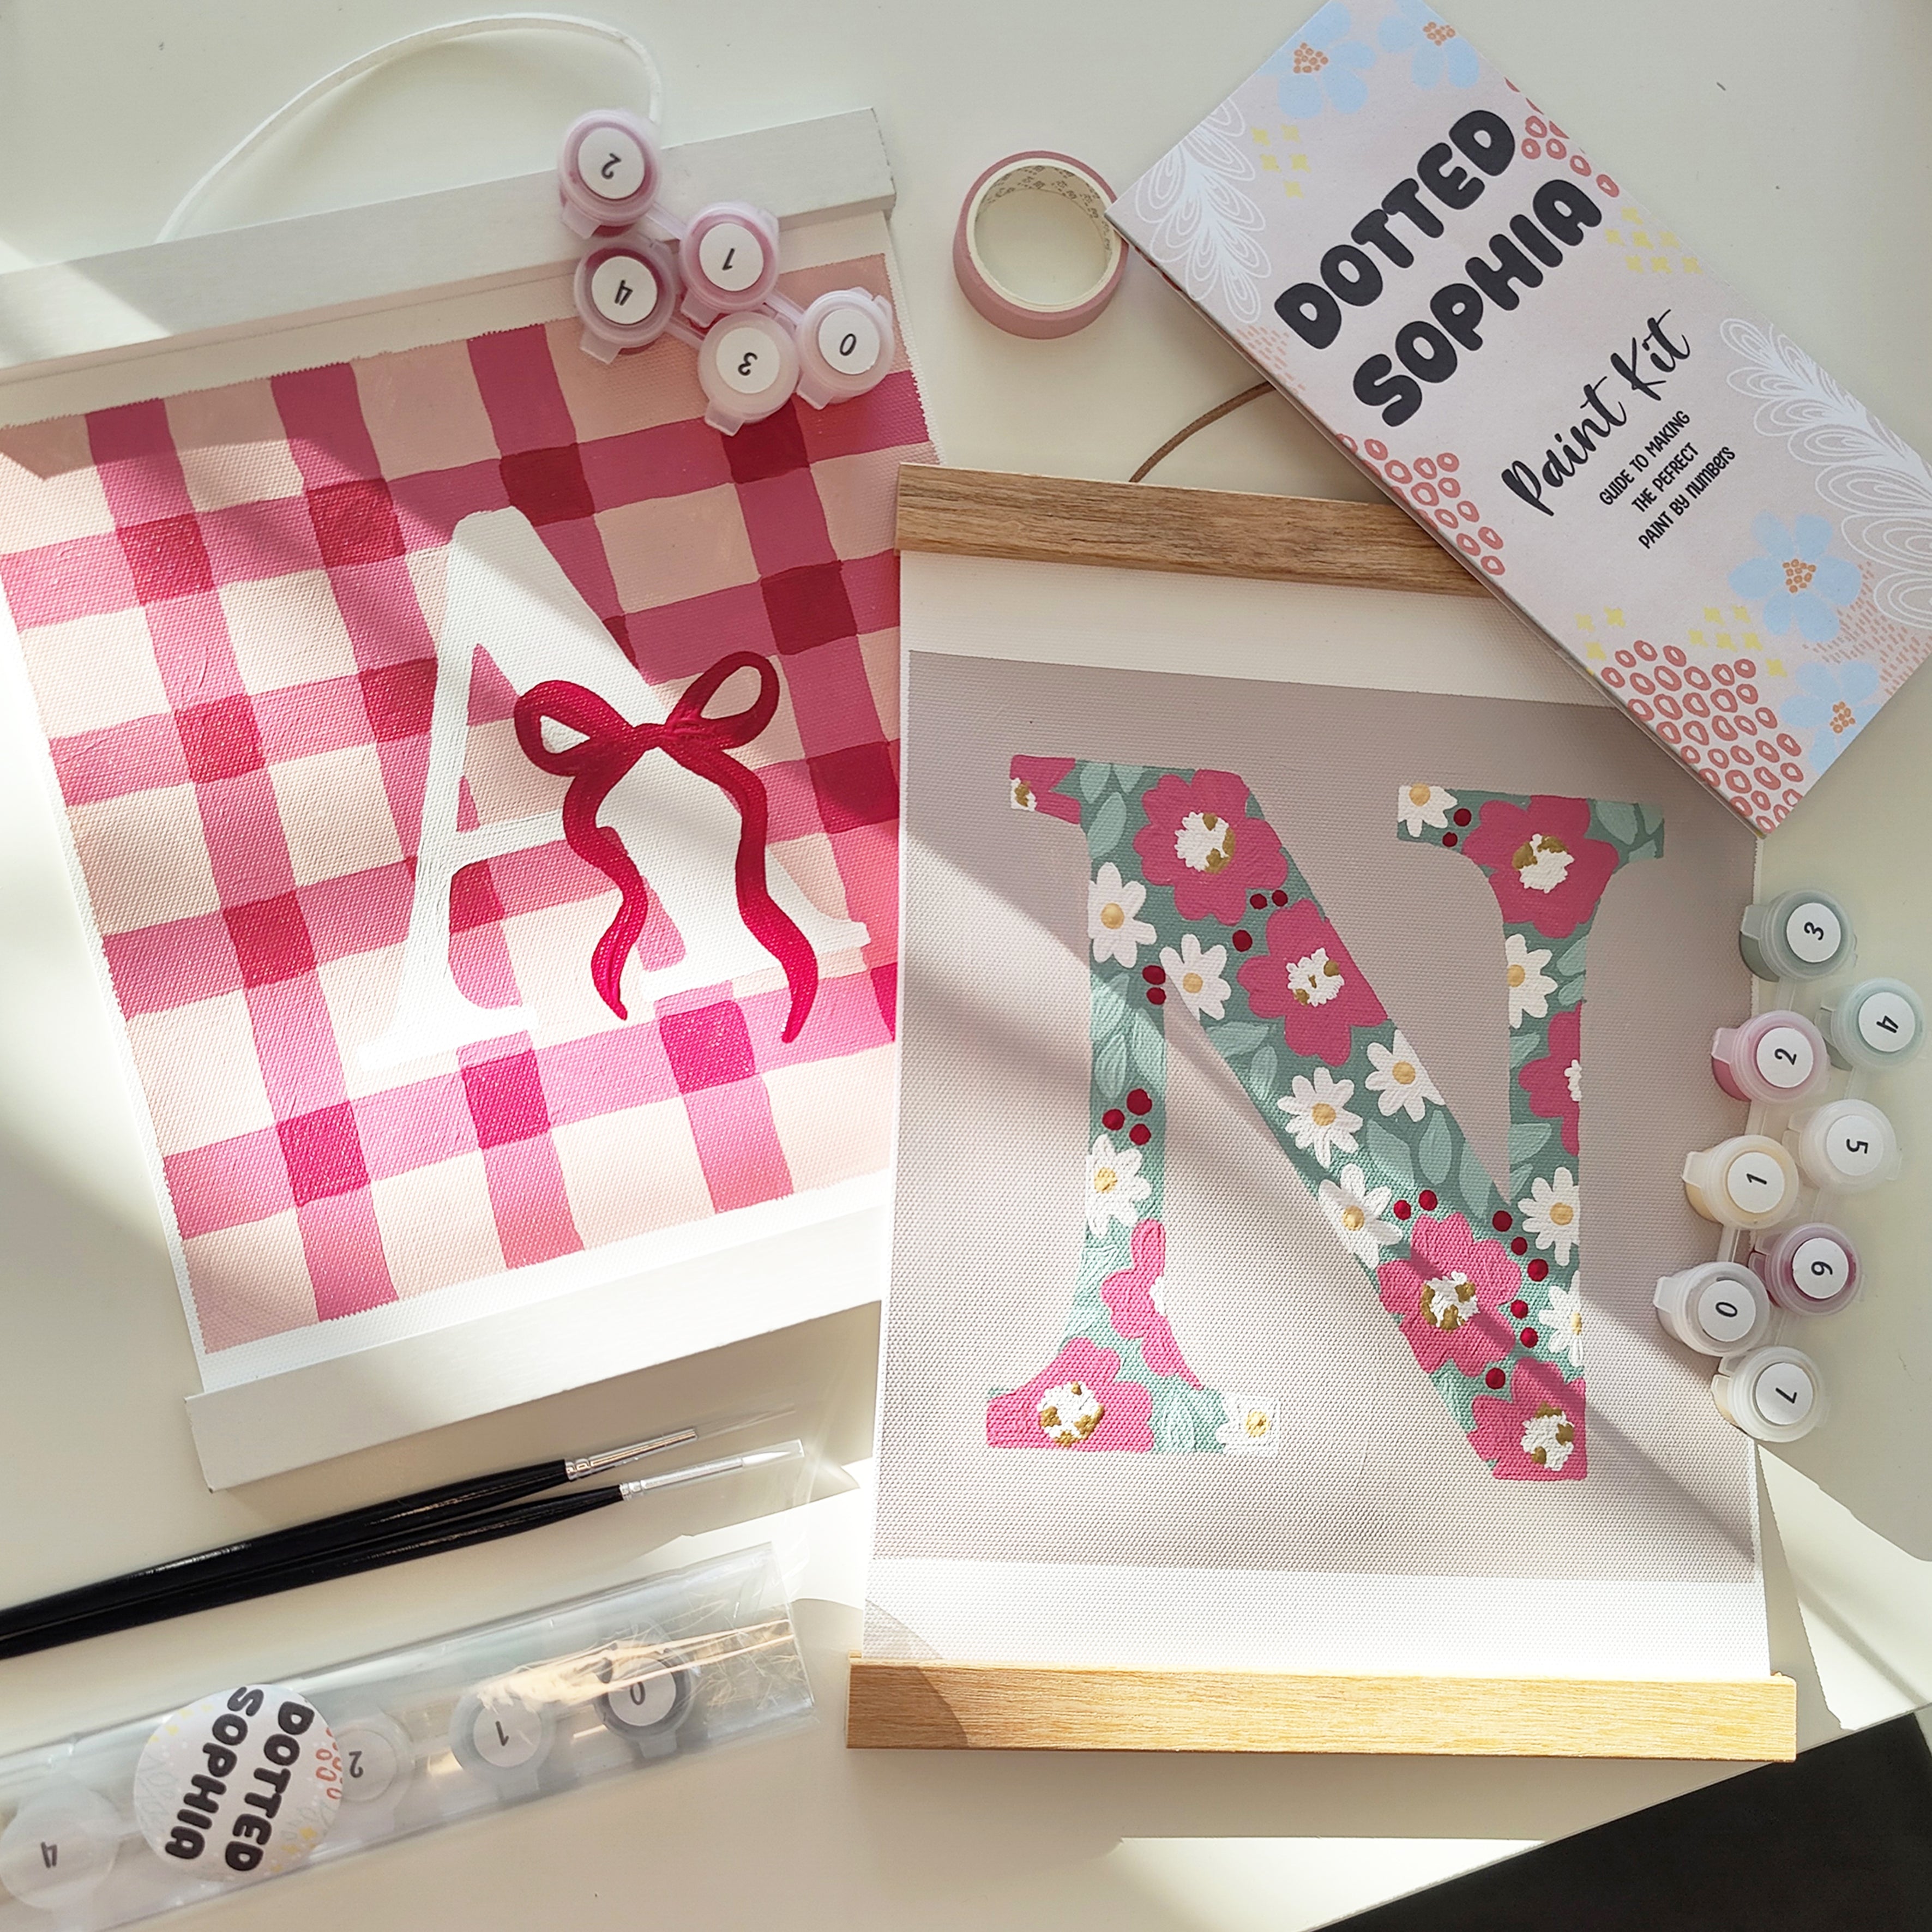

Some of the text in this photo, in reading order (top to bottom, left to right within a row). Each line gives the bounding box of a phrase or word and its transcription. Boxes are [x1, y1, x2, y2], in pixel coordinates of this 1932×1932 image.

[601, 153, 621, 179] 2
[1274, 110, 1515, 349] DOTTED
[721, 248, 736, 271] 1
[614, 280, 633, 306] 4
[1353, 179, 1602, 427] SOPHIA
[839, 333, 857, 356] 0
[737, 352, 758, 376] 3
[1501, 309, 1690, 516] Paint Kit
[1599, 410, 1690, 505] GUIDE TO MAKING
[1632, 442, 1699, 513] THE PEFRECT
[1638, 511, 1674, 549] PAINT
[1804, 922, 1824, 941] 3
[1876, 1015, 1899, 1033] 4
[1774, 1048, 1797, 1066] 2
[1846, 1139, 1869, 1154] 5
[1746, 1173, 1767, 1185] 1
[1715, 1302, 1738, 1318] 0
[1775, 1387, 1798, 1404] 7
[629, 1681, 646, 1706] 0
[495, 1720, 509, 1747] 1
[165, 1687, 264, 1859] SOPHIA
[348, 1750, 364, 1778] 2
[225, 1701, 315, 1871] DOTTED
[41, 1841, 58, 1868] 4
